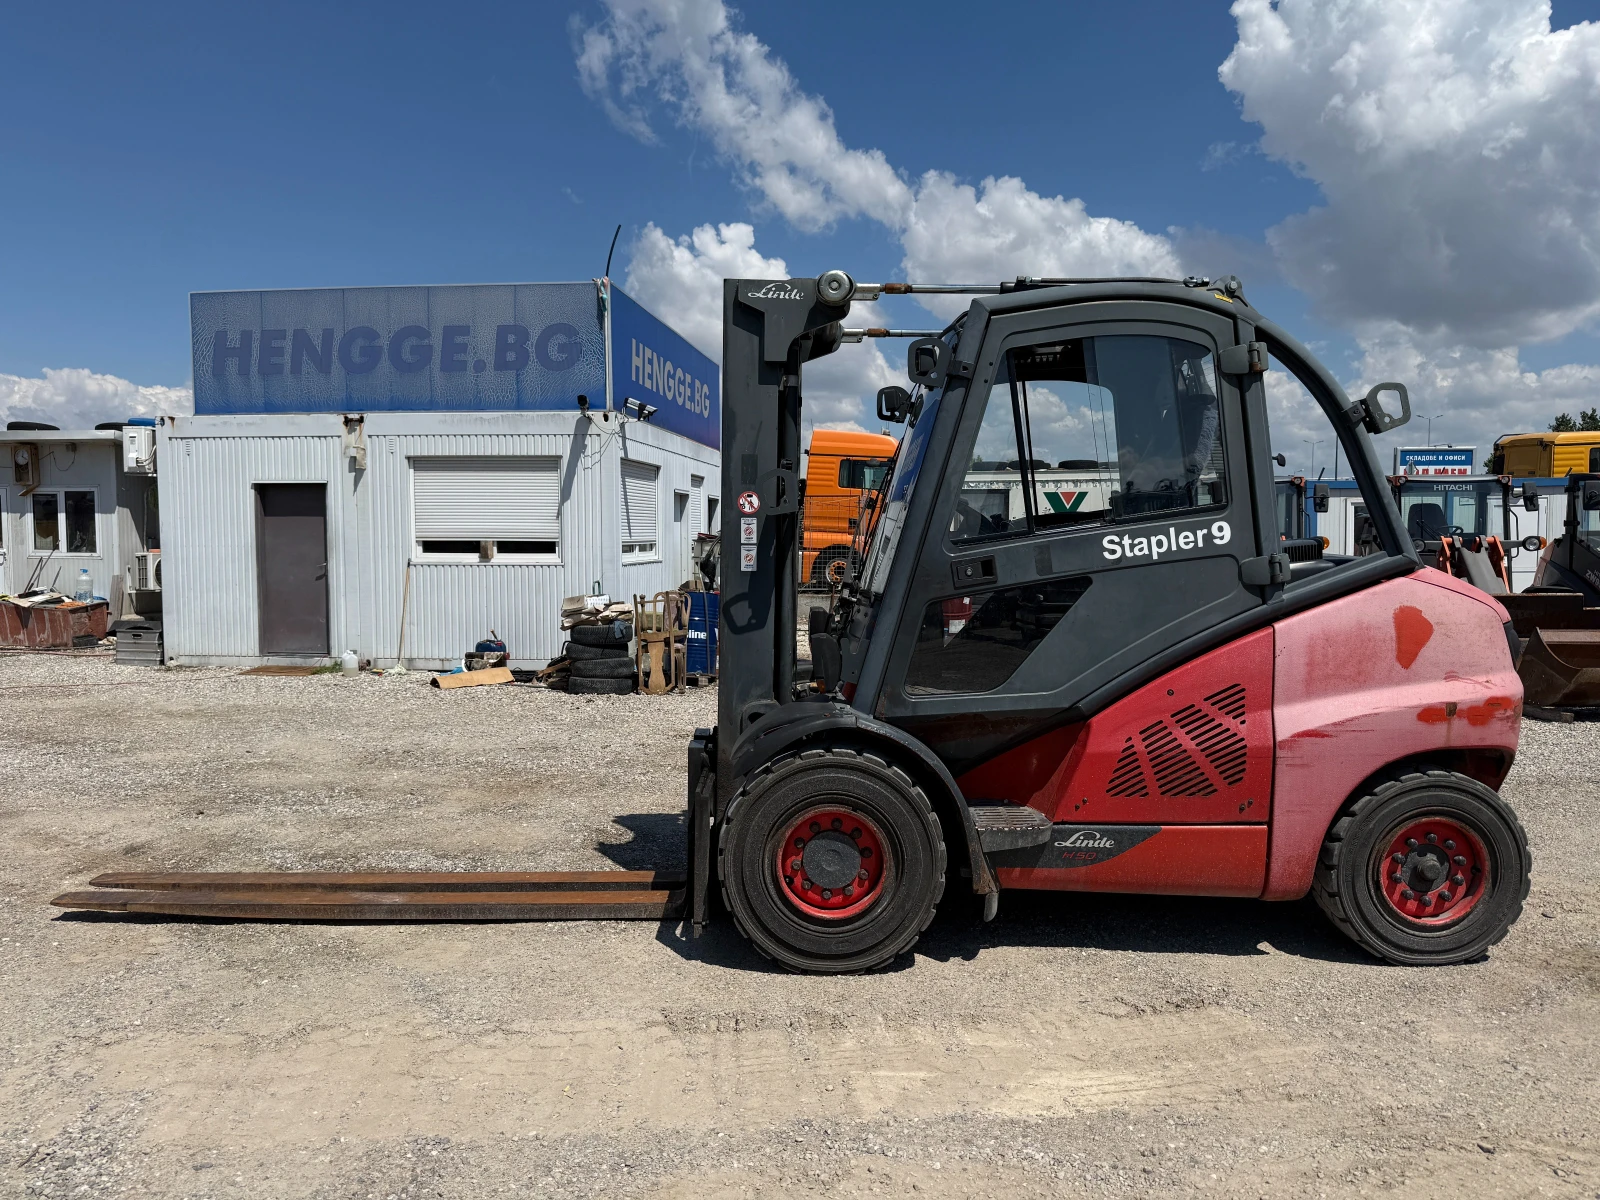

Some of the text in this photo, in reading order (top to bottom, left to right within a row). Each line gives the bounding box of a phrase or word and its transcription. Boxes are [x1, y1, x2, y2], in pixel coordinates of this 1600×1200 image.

[748, 282, 804, 300] Linde
[212, 322, 583, 376] HENGGE.BG
[631, 337, 709, 419] HENGGE.BG
[687, 629, 707, 639] line
[1054, 830, 1115, 848] Linde
[1062, 851, 1097, 860] H50
